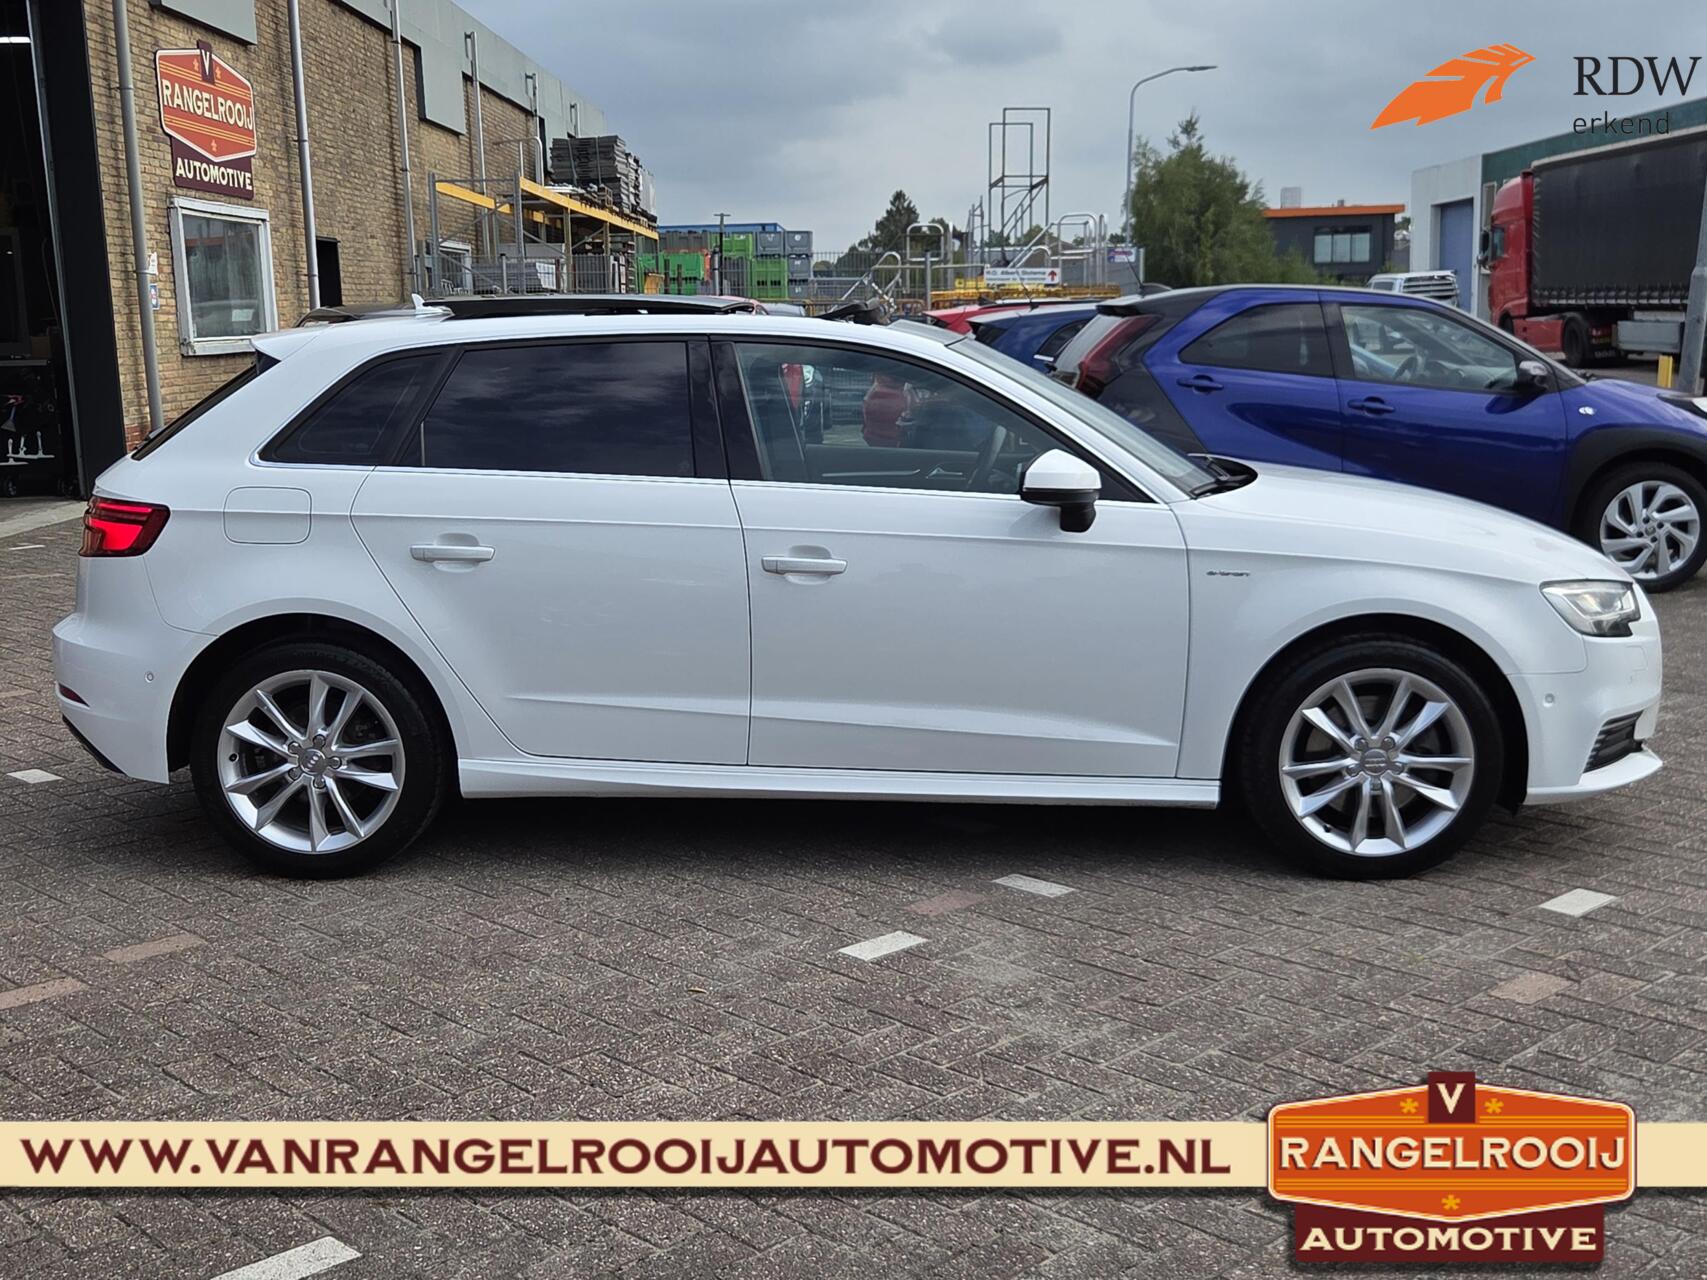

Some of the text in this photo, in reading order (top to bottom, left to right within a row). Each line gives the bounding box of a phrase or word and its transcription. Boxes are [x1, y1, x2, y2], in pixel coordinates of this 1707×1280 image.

[201, 49, 210, 76] V
[162, 79, 253, 131] RANGELROOIJ
[175, 157, 253, 191] AUTOMOTIVE
